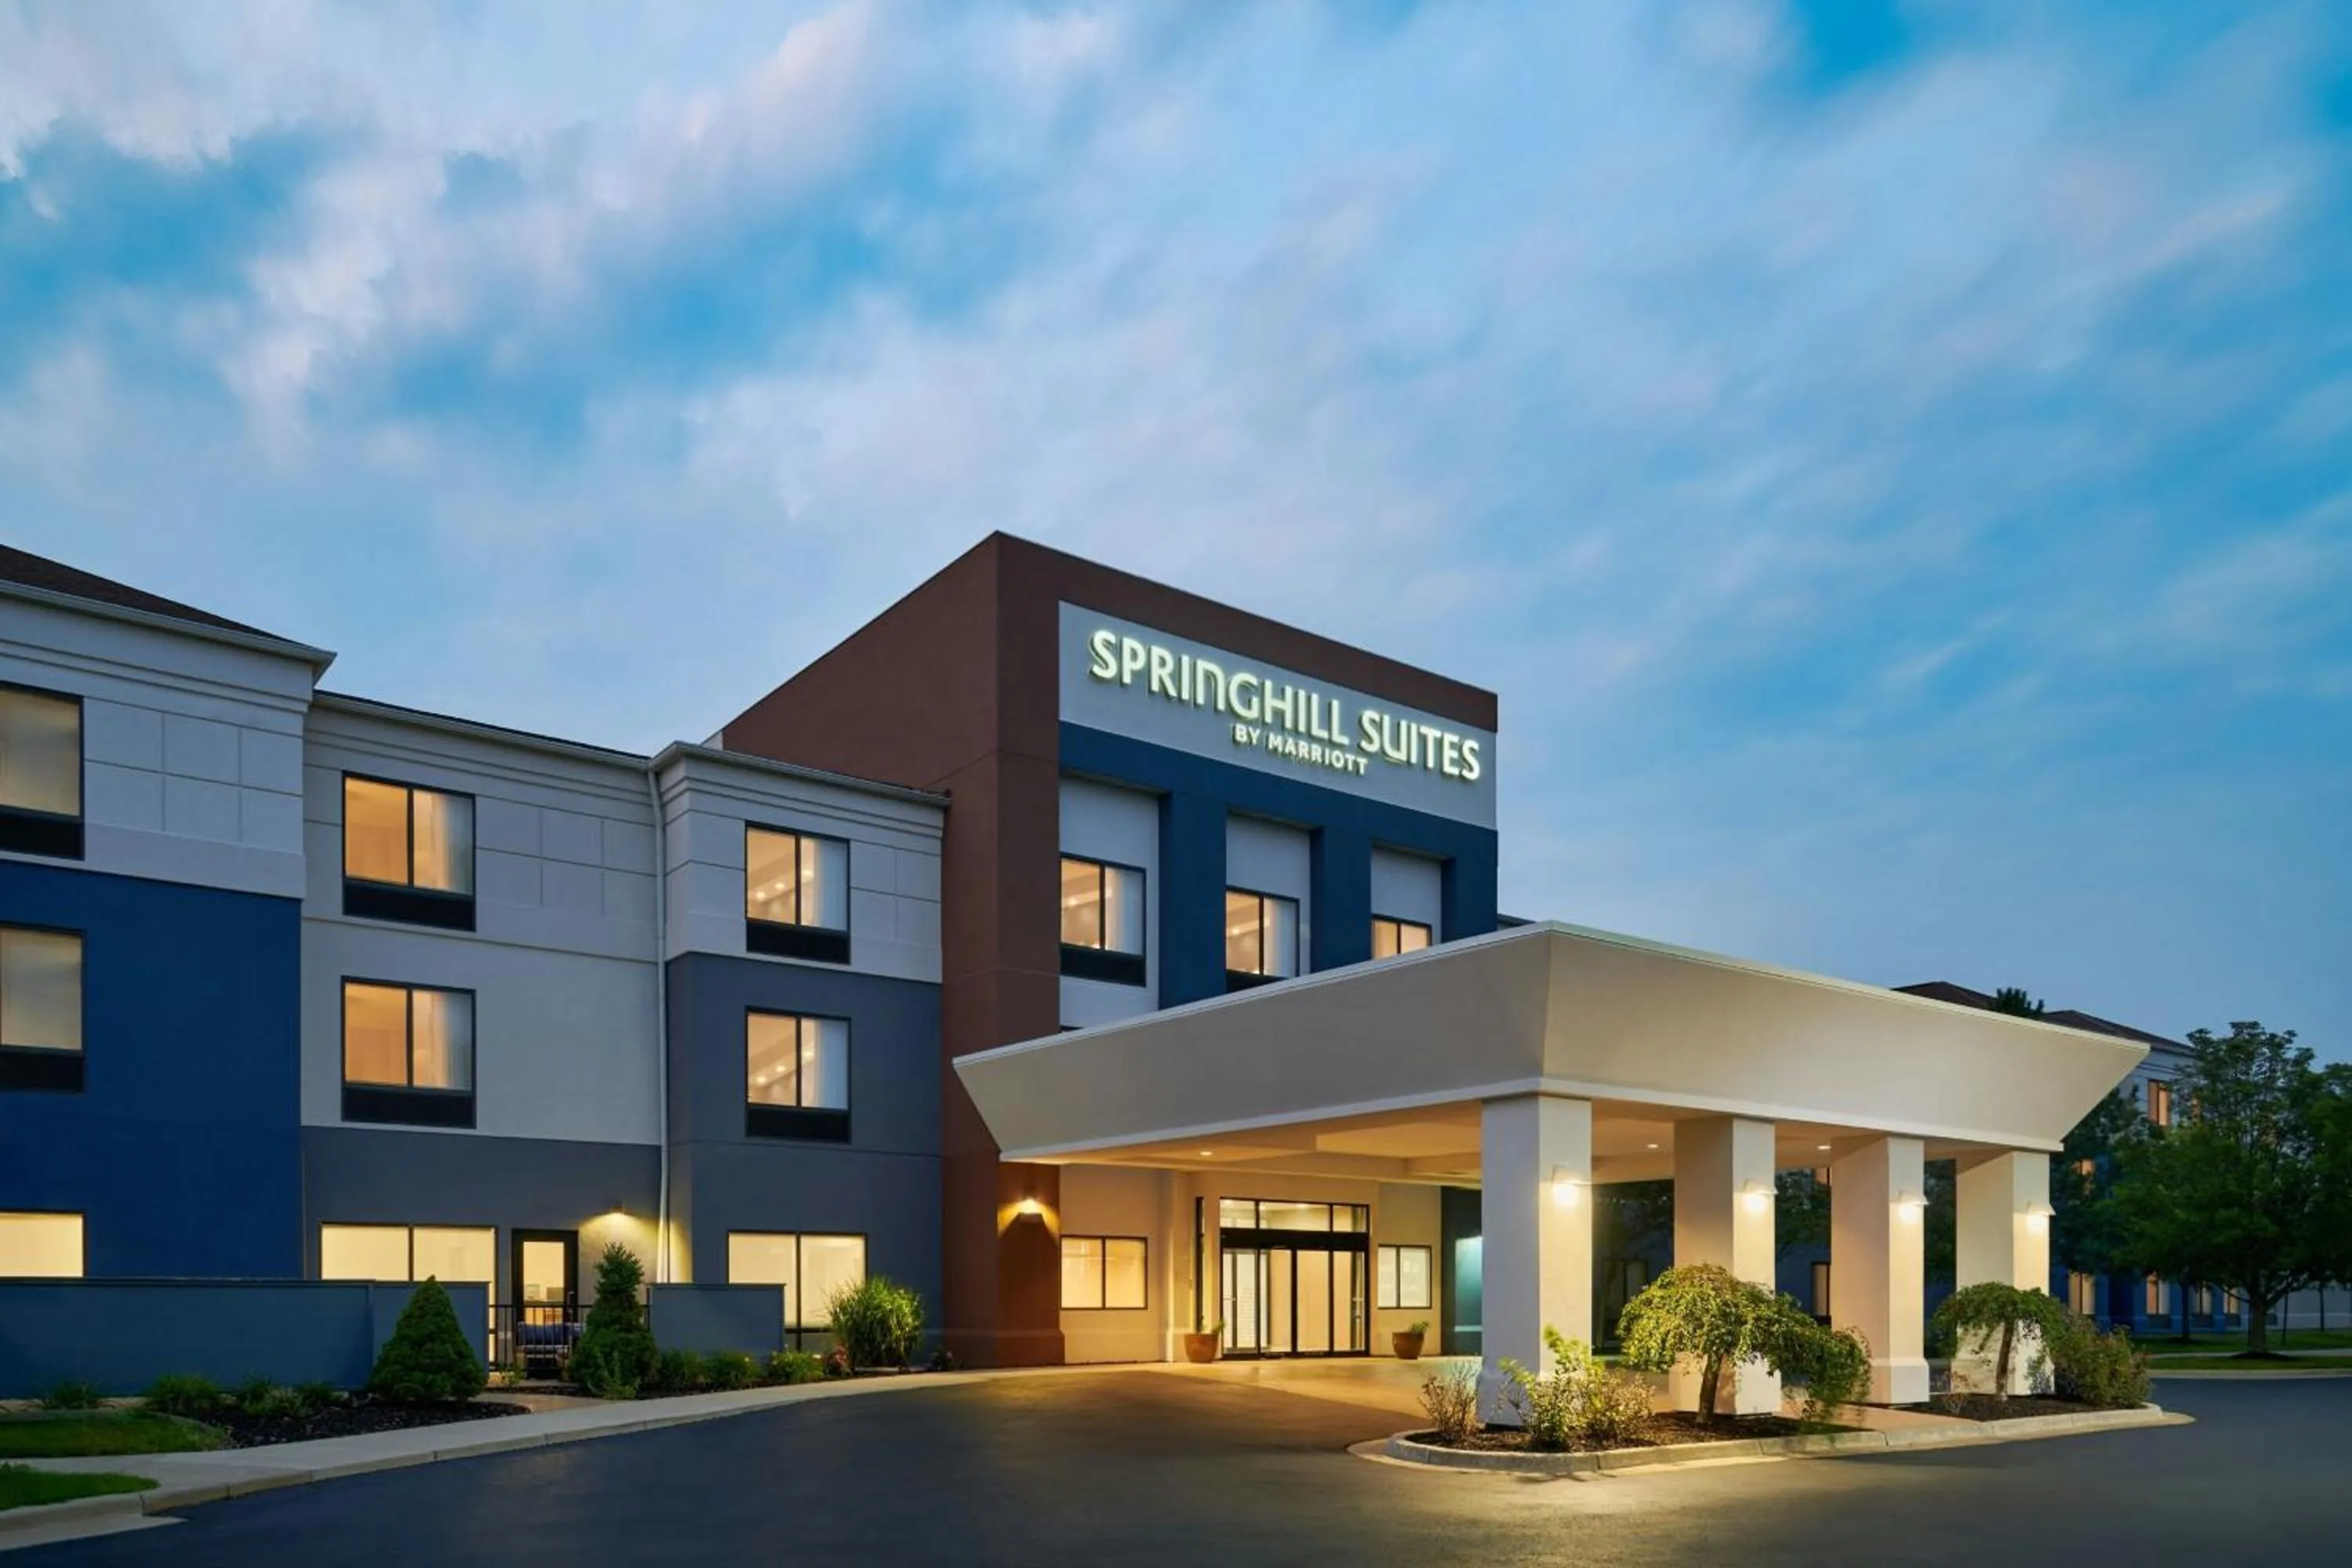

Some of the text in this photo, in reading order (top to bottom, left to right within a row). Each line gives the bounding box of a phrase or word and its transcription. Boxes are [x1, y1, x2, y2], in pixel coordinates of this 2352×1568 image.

[1091, 630, 1481, 781] SPRINGHILL SUITES
[1233, 724, 1368, 776] BY MARRIOTT
